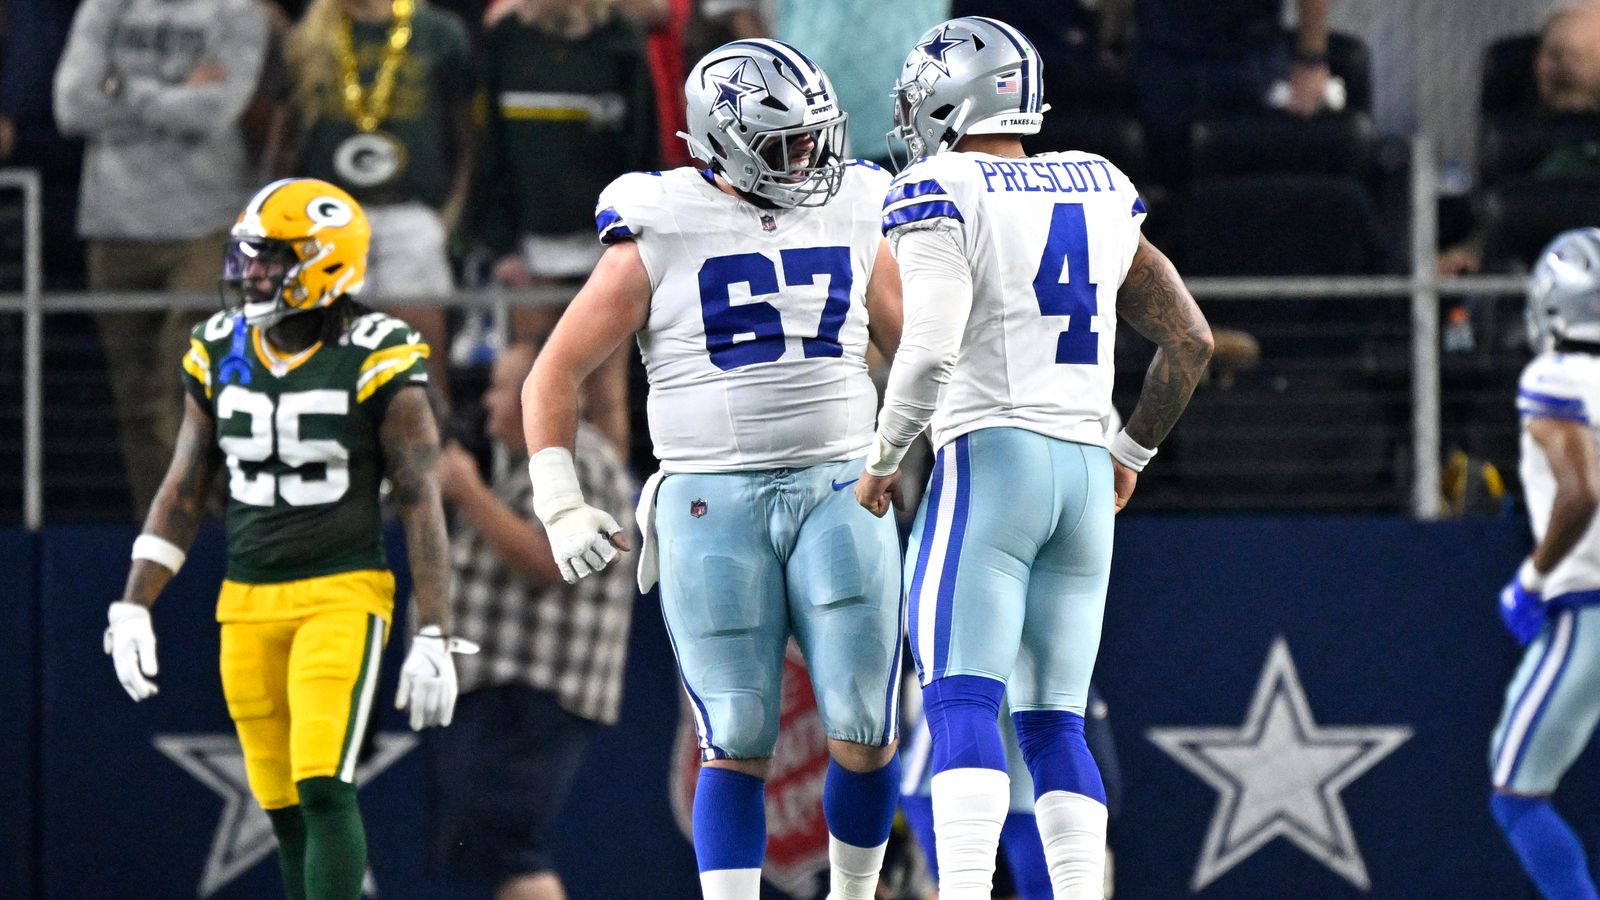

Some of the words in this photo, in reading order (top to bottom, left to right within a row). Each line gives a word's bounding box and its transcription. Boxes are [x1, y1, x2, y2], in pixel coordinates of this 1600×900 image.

[1009, 118, 1030, 126] TAKES
[306, 195, 353, 228] G
[974, 159, 1117, 193] PRESCOTT
[697, 245, 854, 372] 67
[1032, 202, 1099, 366] 4
[217, 384, 350, 507] 25
